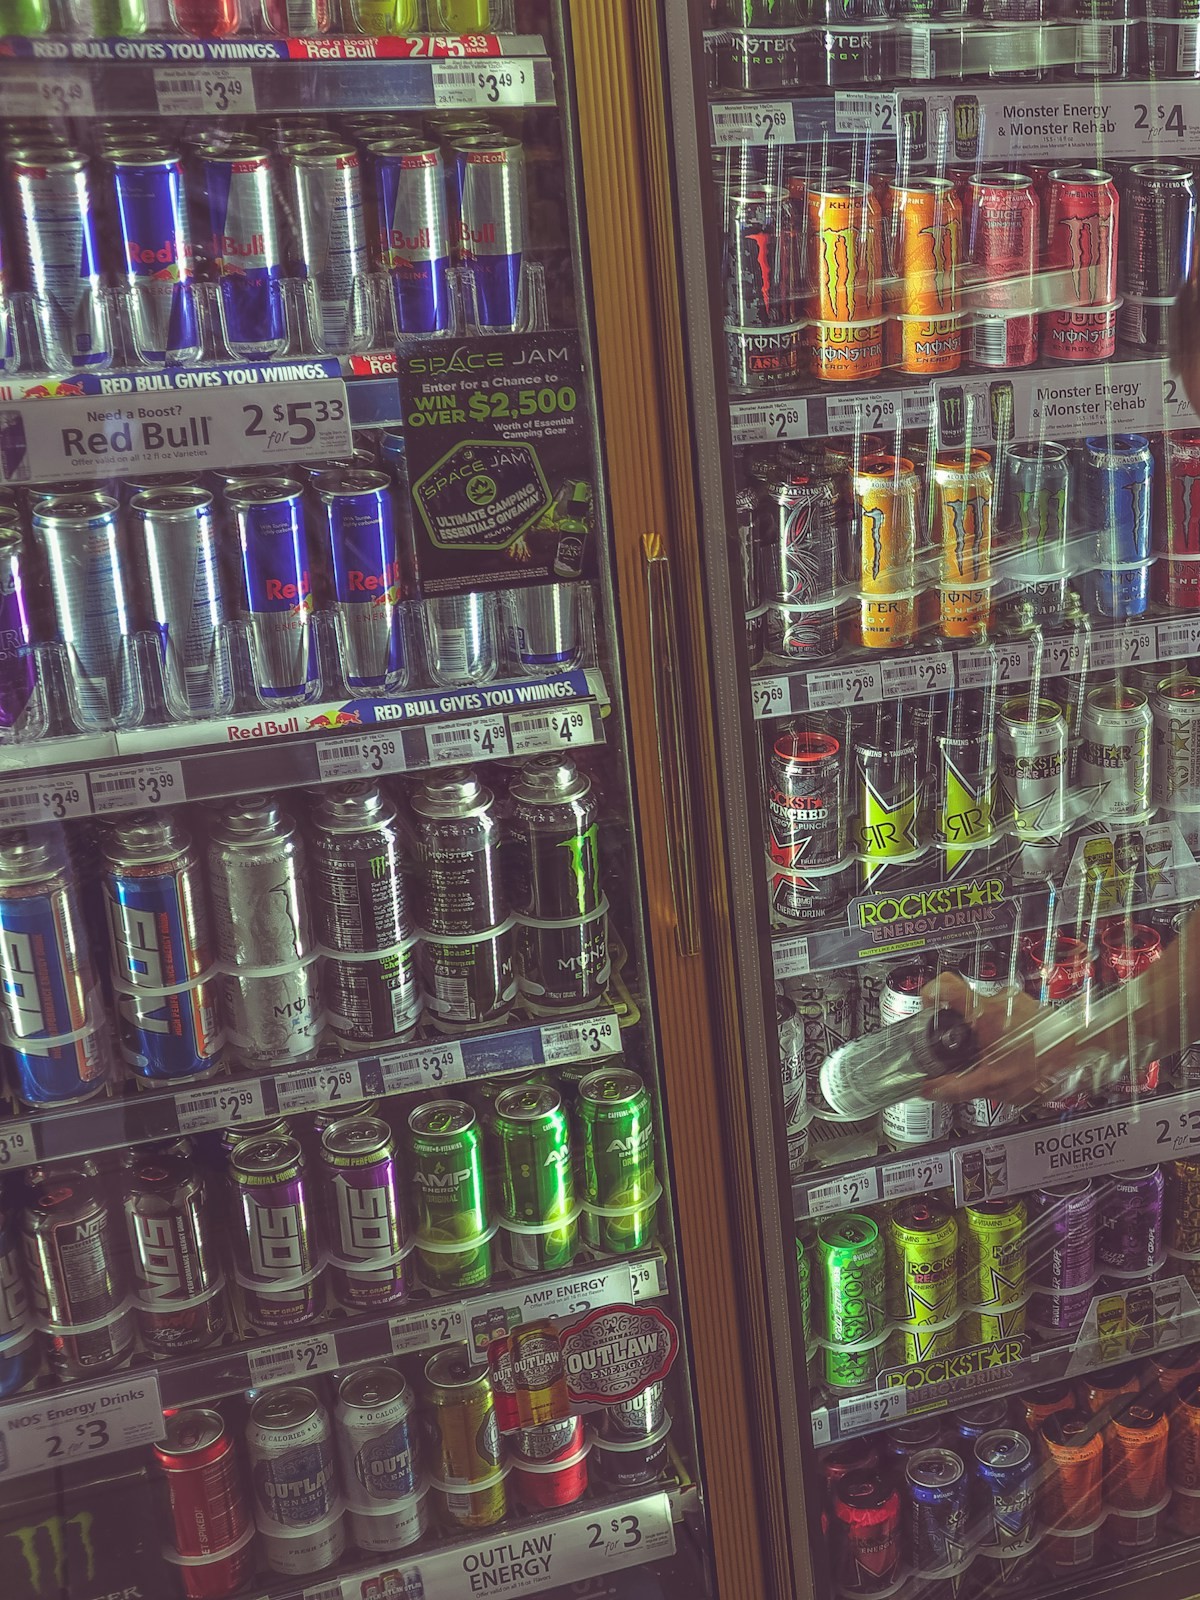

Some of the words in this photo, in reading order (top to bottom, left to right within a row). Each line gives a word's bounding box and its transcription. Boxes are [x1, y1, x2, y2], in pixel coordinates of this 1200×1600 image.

[32, 41, 69, 59] RED
[71, 42, 114, 59] BULL
[115, 43, 166, 59] GIVES
[162, 43, 204, 59] YOU
[210, 43, 280, 59] WIIINGS.
[307, 45, 341, 58] Red
[344, 45, 376, 58] Bull
[1003, 104, 1060, 118] Monster
[1064, 103, 1110, 120] Energy
[1133, 104, 1150, 130] 2
[1147, 126, 1164, 139] for
[998, 127, 1007, 136] &
[1010, 122, 1069, 135] Monster
[1073, 120, 1115, 134] Rehab
[983, 211, 1021, 219] JUICE
[362, 353, 393, 363] Need
[409, 347, 503, 375] SPACE
[513, 347, 568, 365] JAM
[100, 376, 132, 395] RED
[135, 373, 174, 392] BULL
[175, 371, 221, 391] GIVES
[222, 368, 258, 387] YOU
[259, 362, 329, 384] WIIINGS.
[422, 382, 456, 394] Enter
[460, 380, 479, 391] for
[482, 380, 489, 388] a
[491, 374, 542, 388] Chance
[545, 373, 558, 383] to
[1036, 386, 1091, 400] Monster
[1094, 383, 1140, 401] Energy
[1163, 380, 1179, 403] 2
[87, 408, 122, 423] Need
[125, 411, 134, 420] a
[138, 405, 183, 418] Boost?
[413, 394, 456, 411] WIN
[468, 386, 577, 423] $2,500
[1032, 409, 1041, 418] &
[1044, 403, 1099, 417] Monster
[1104, 398, 1147, 413] Rehab
[242, 404, 268, 438] 2
[267, 429, 289, 450] for
[408, 410, 466, 427] OVER
[493, 421, 521, 432] Worth
[522, 420, 532, 430] of
[534, 417, 574, 429] Essential
[61, 422, 133, 457] Red
[142, 416, 210, 449] Bull
[502, 429, 543, 441] Camping
[544, 426, 567, 436] Gear
[71, 456, 94, 467] Offer
[117, 455, 129, 463] on
[424, 460, 487, 500] SPACE
[490, 452, 526, 468] JAM
[435, 507, 488, 528] ULTIMATE
[488, 483, 536, 515] CAMPING
[438, 517, 496, 541] ESSENTIALS
[496, 491, 543, 525] GIVEAWAY
[266, 571, 310, 600] Red
[373, 704, 402, 722] RED
[405, 699, 439, 718] BULL
[441, 695, 482, 714] GIVES
[485, 691, 514, 708] YOU
[516, 681, 577, 703] WIIINGS.
[226, 723, 263, 741] Red
[265, 717, 299, 736] Bull
[802, 909, 826, 918] DRINK
[859, 879, 1004, 928] ROCKSTAR
[872, 915, 937, 941] ENERGY
[944, 905, 995, 930] DRINK
[1034, 1122, 1127, 1156] ROCKSTAR
[1155, 1119, 1172, 1144] 2
[1172, 1133, 1189, 1150] for
[1049, 1140, 1117, 1169] ENERGY
[412, 1168, 471, 1184] AMP
[422, 1185, 461, 1194] ENERGY
[1116, 1184, 1139, 1194] CAFFEINE
[523, 1289, 554, 1305] AMP
[557, 1277, 606, 1298] ENERGY
[593, 1332, 634, 1345] ORIGINAL
[514, 1353, 560, 1372] OUTLAW
[567, 1333, 660, 1374] OUTLAW
[590, 1358, 646, 1380] ENERGY
[965, 1366, 1013, 1388] DRINK
[46, 1400, 97, 1421] Energy
[100, 1389, 145, 1407] Drinks
[268, 1429, 306, 1442] CALORIES
[45, 1436, 65, 1458] 2
[585, 1522, 605, 1549] 2
[603, 1537, 620, 1556] for
[462, 1533, 552, 1573] OUTLAW
[469, 1554, 552, 1592] ENERGY
[475, 1589, 491, 1599] Offer
